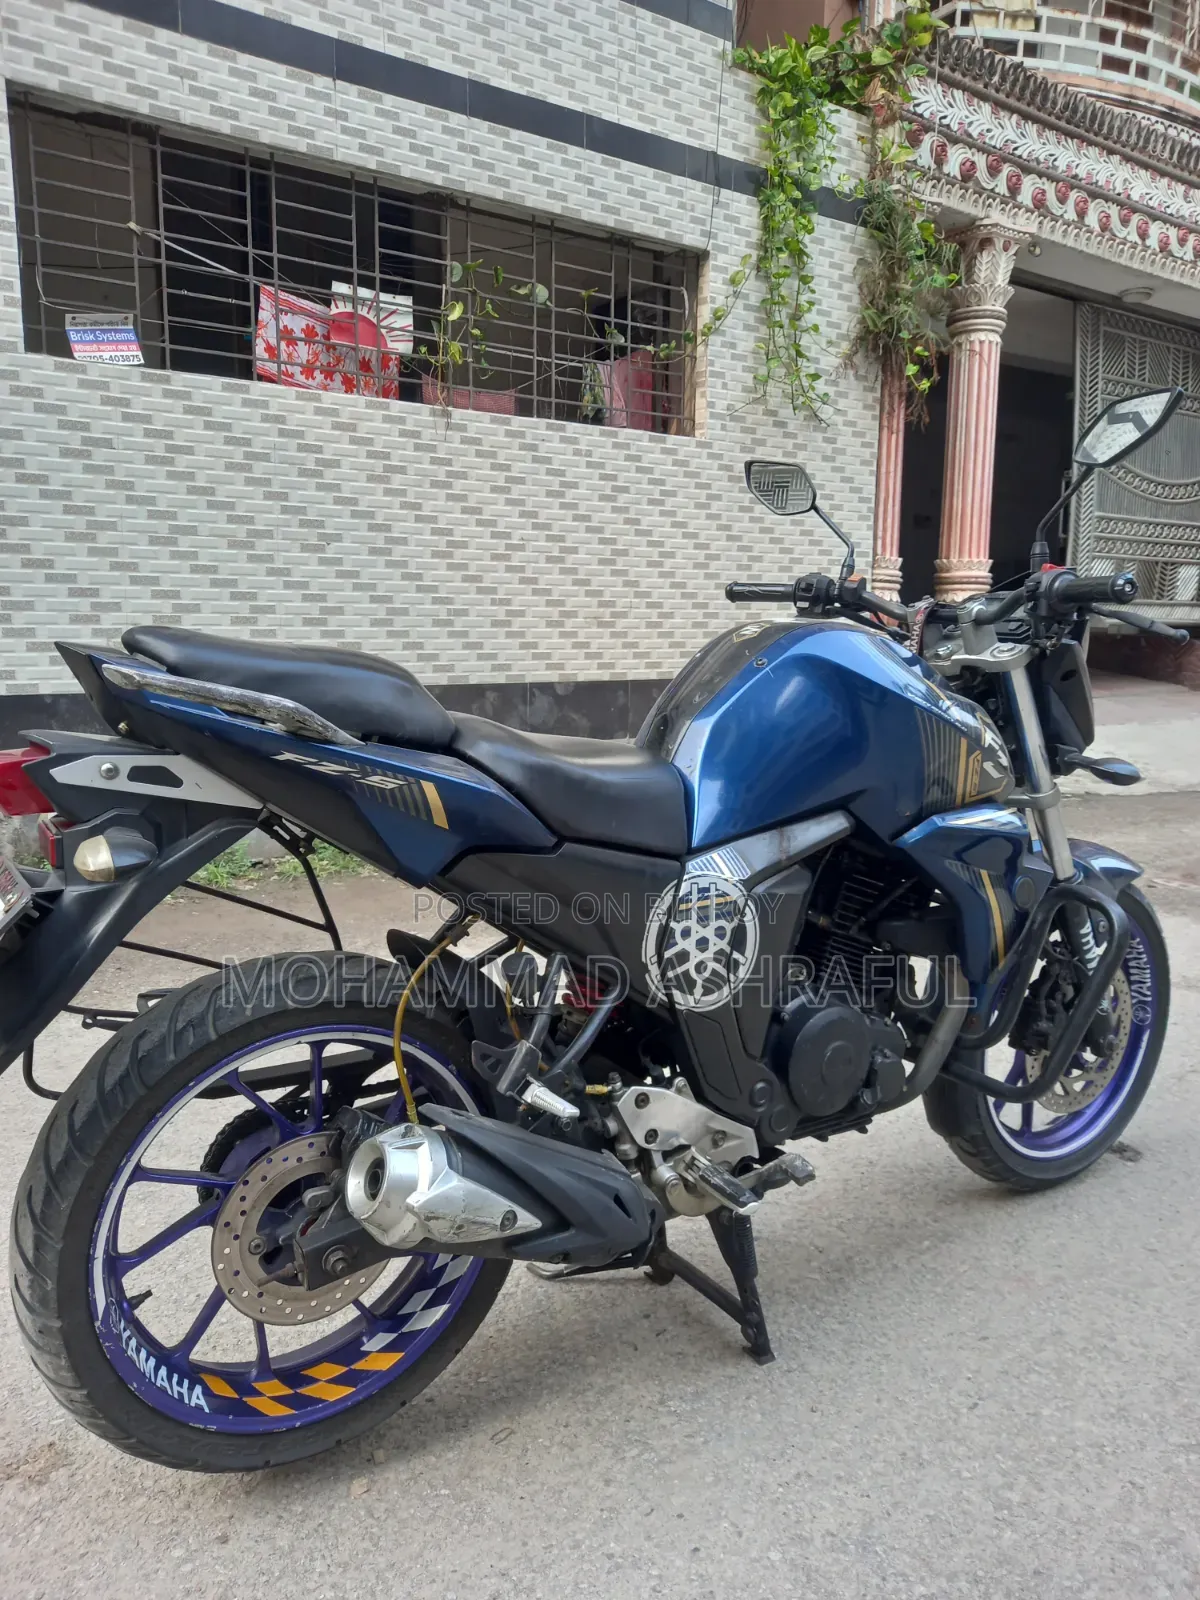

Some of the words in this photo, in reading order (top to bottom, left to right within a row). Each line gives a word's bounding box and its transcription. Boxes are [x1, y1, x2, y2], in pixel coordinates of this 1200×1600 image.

[70, 330, 96, 341] Brisk
[96, 331, 135, 343] Systems
[1126, 937, 1153, 1004] YAMAHA
[120, 1317, 210, 1413] YAMAHA
